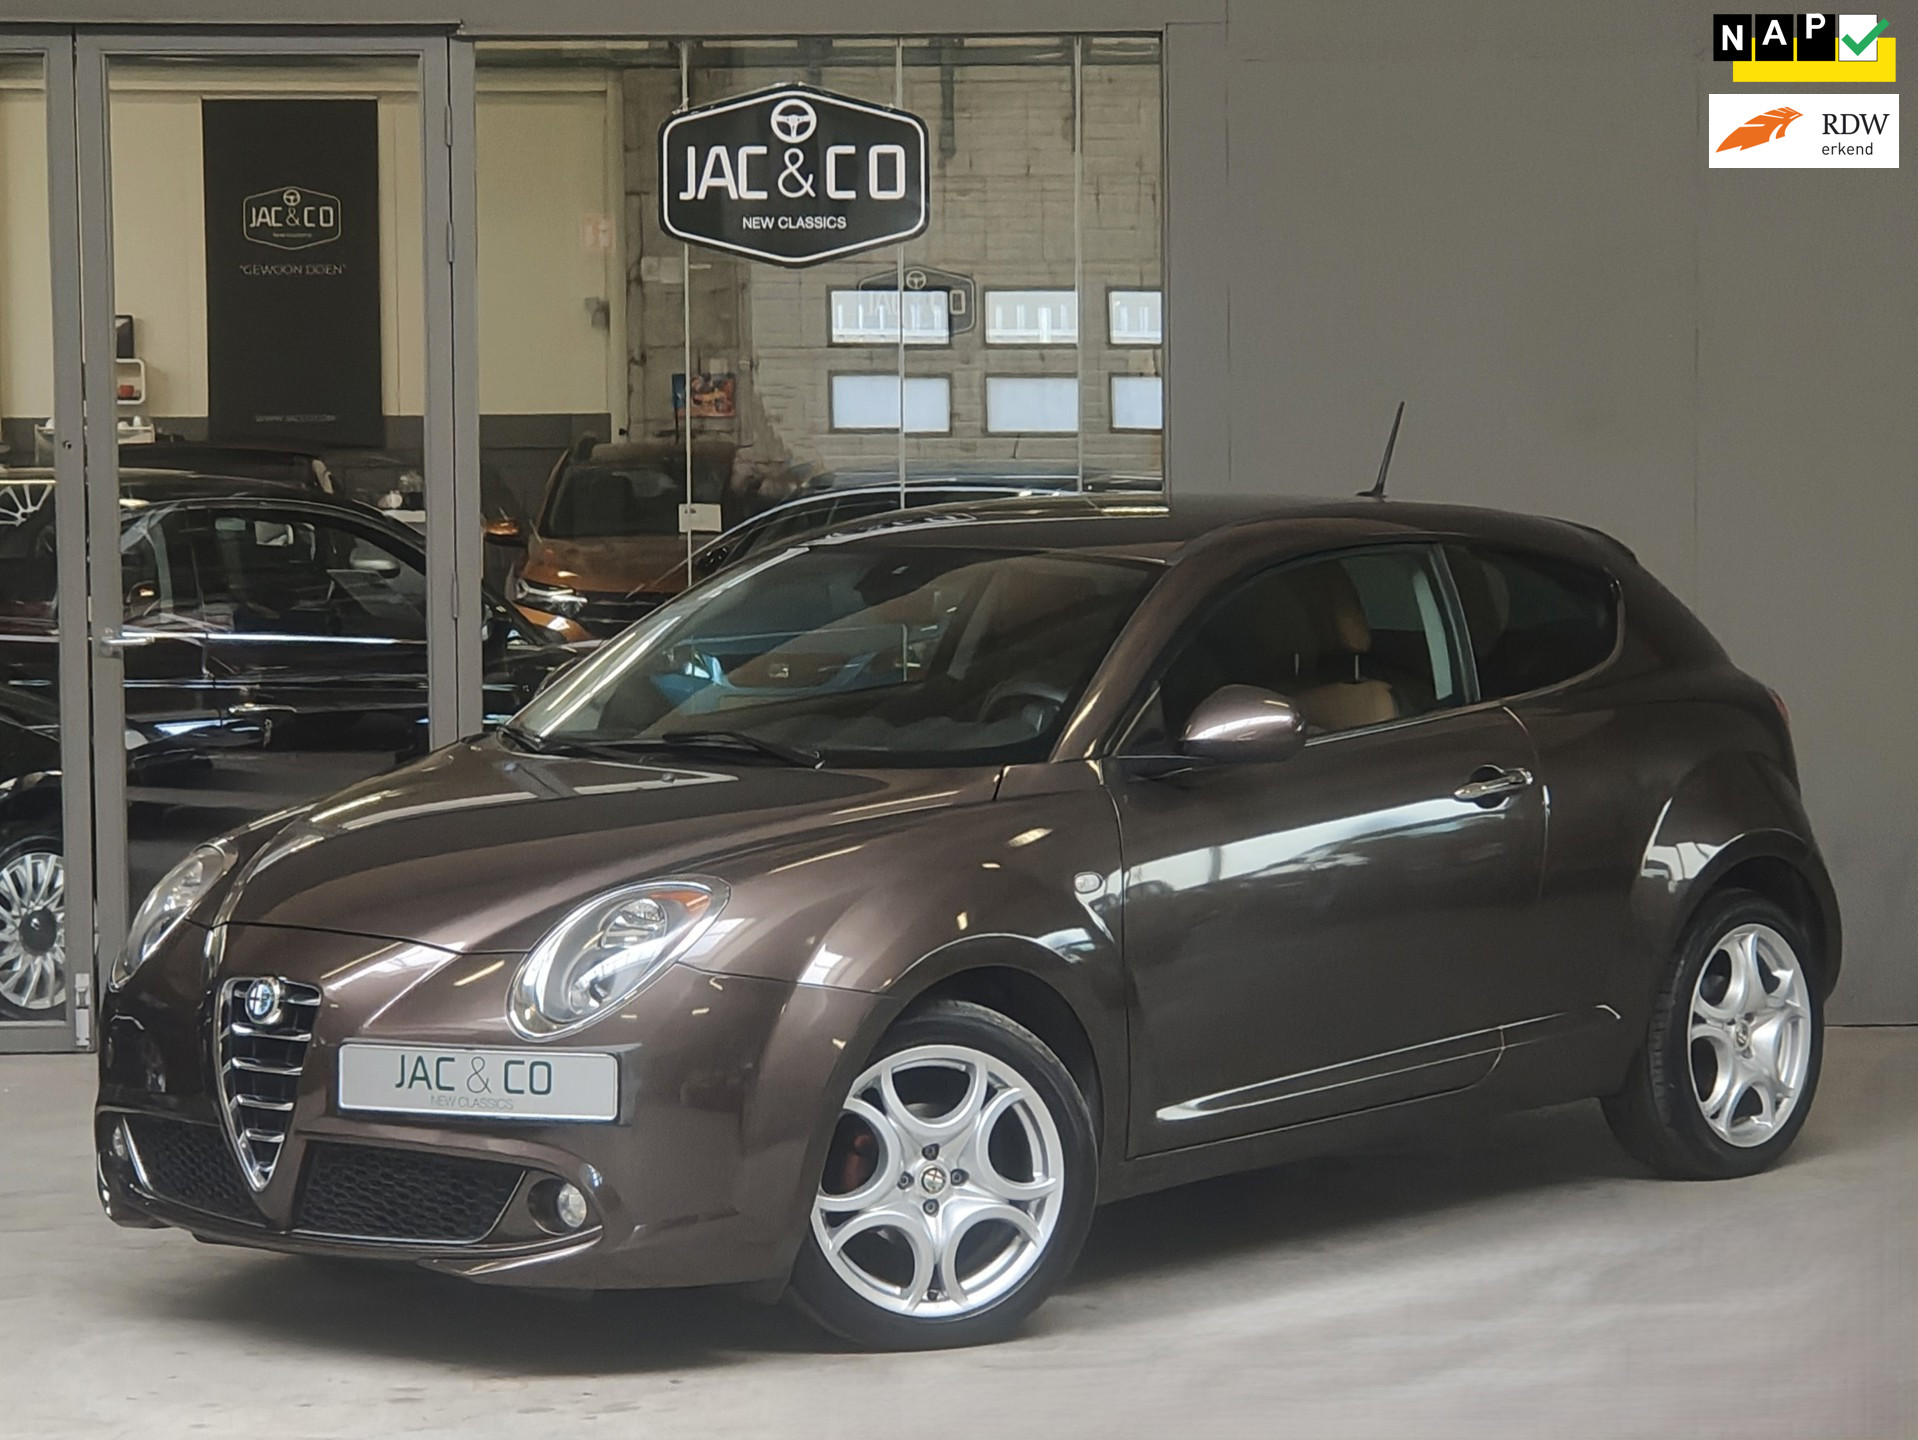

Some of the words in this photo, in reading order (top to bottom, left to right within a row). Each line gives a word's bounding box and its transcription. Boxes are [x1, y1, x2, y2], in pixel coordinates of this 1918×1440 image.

[679, 145, 768, 200] JAC
[777, 147, 816, 198] &
[826, 144, 906, 200] CO
[250, 206, 283, 228] JAC
[285, 207, 300, 226] &
[303, 206, 334, 228] CO
[742, 216, 775, 230] NEW
[777, 216, 847, 230] CLASSICS
[395, 1054, 456, 1092] JAC
[466, 1056, 493, 1094] &
[503, 1059, 553, 1096] CO
[430, 1095, 456, 1107] NEW
[457, 1096, 514, 1110] CLASSICS
